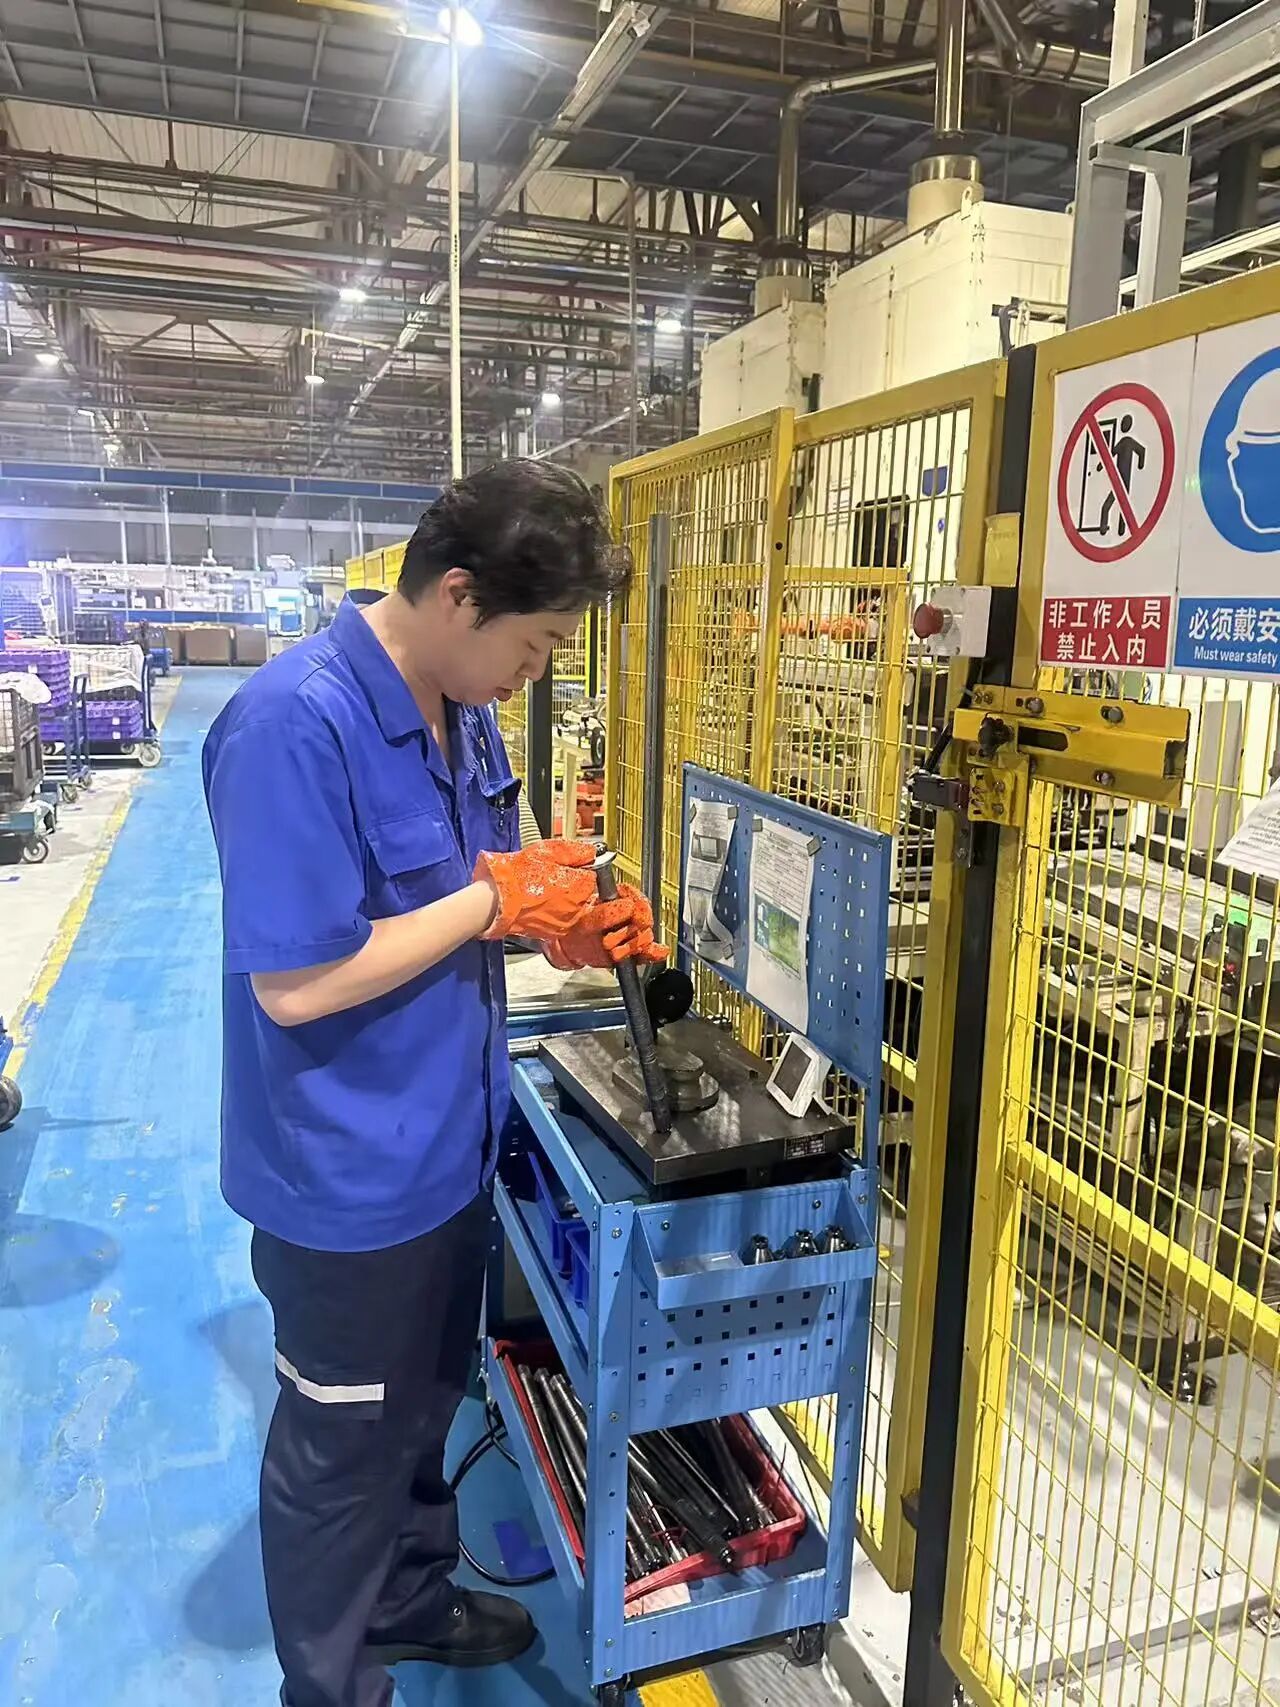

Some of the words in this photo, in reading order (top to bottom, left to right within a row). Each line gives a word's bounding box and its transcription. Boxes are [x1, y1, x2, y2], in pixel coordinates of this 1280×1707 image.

[1048, 599, 1161, 630] 非工作人员
[1188, 606, 1280, 643] 必须戴安
[1056, 631, 1146, 664] 禁止入内
[1194, 645, 1219, 661] Must
[1220, 649, 1245, 662] wear
[1246, 648, 1279, 668] safety
